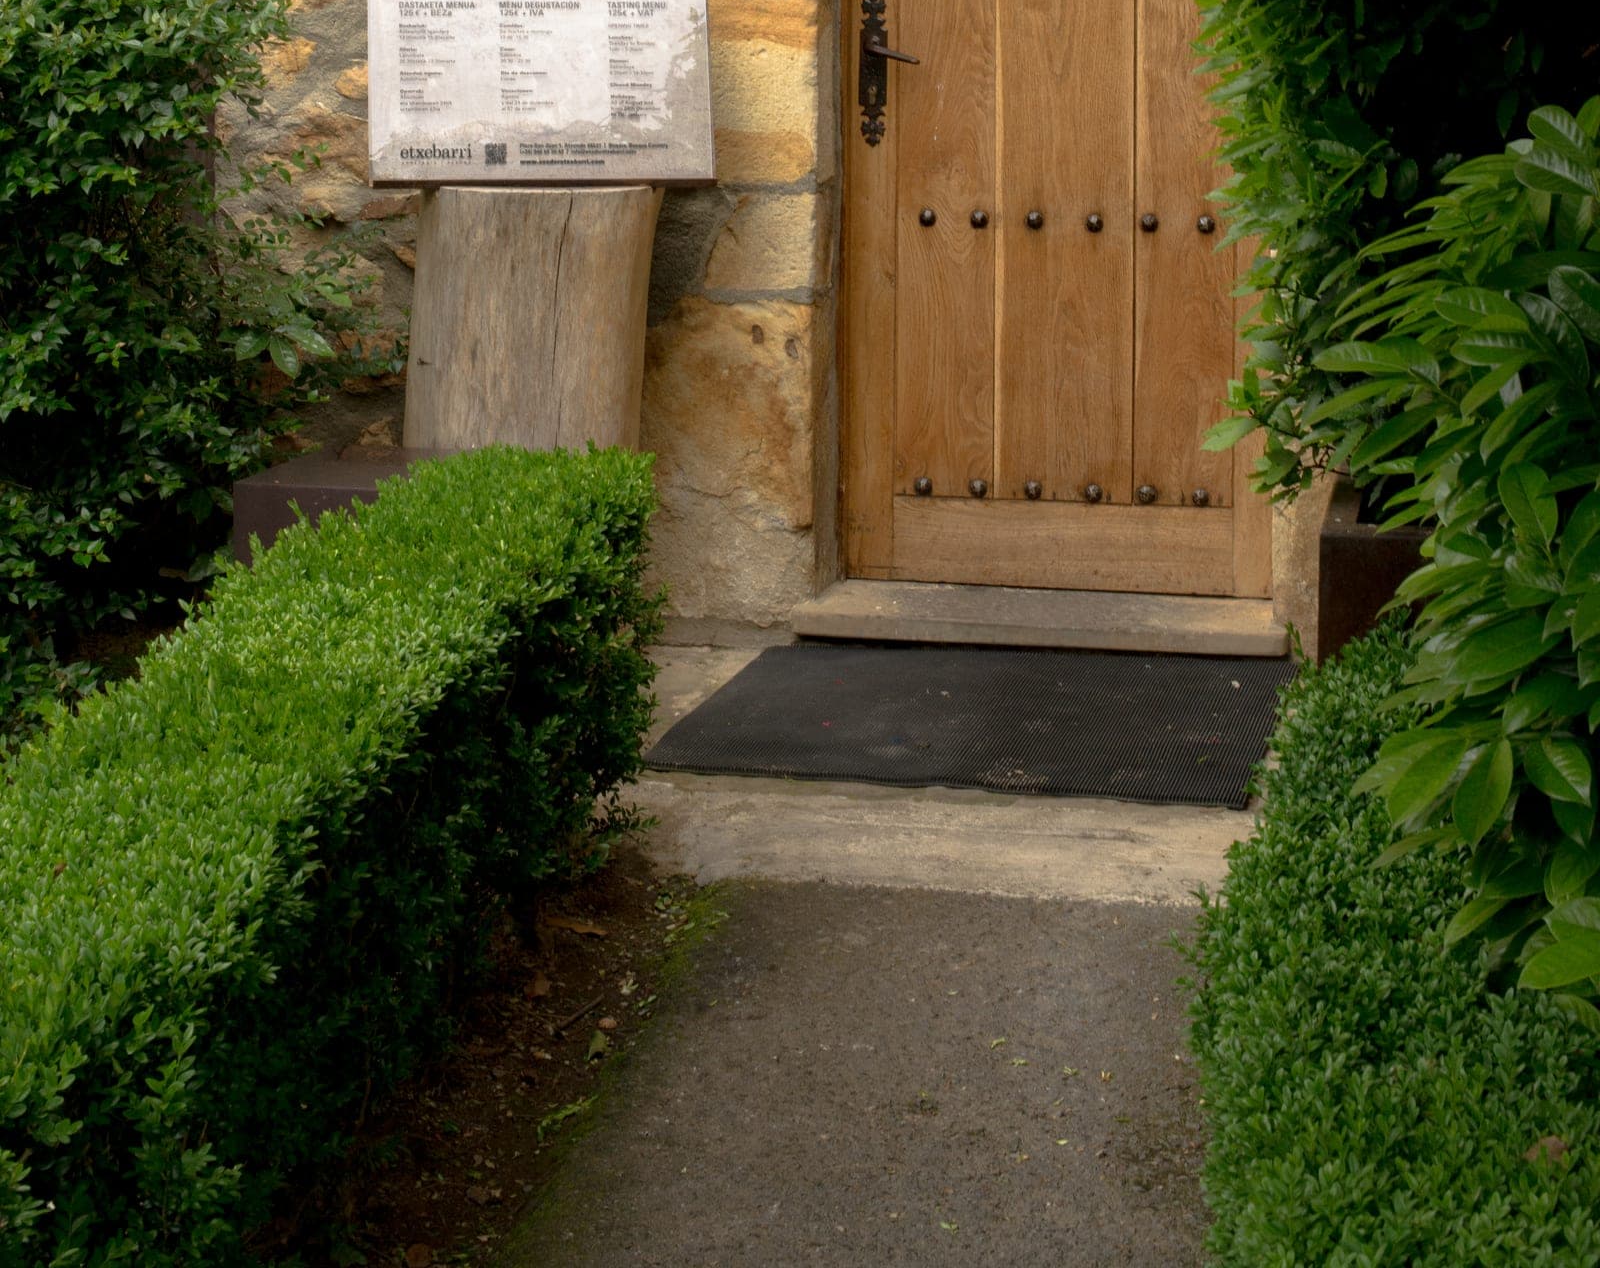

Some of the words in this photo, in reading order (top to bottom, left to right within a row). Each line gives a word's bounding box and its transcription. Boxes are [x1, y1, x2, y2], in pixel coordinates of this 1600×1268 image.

[607, 1, 640, 9] TASTING
[529, 9, 544, 17] IVA
[638, 9, 654, 17] VAT
[400, 143, 472, 159] etxebarri
